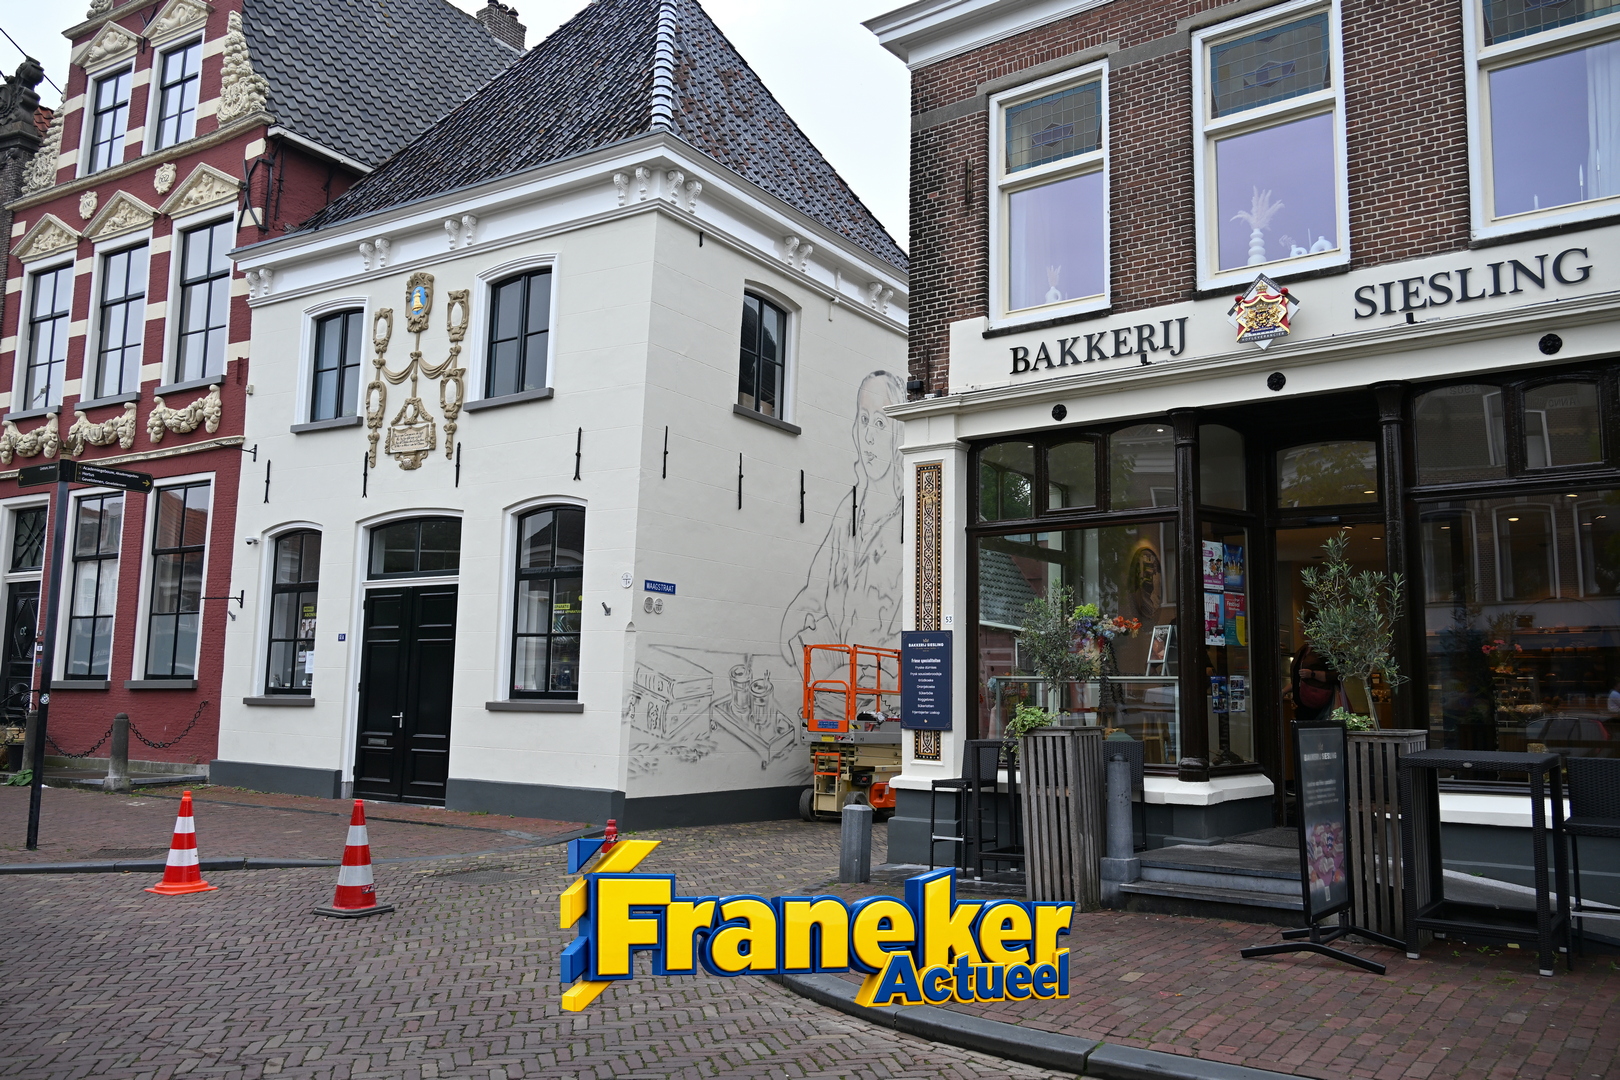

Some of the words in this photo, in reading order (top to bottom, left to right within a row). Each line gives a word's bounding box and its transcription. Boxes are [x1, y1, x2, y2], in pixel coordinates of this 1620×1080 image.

[1354, 247, 1593, 320] SIESLING
[1010, 316, 1188, 375] BAKKERIJ
[1241, 331, 1285, 342] HOFLEVERANCIER
[646, 582, 674, 593] WAAGSTRAAT
